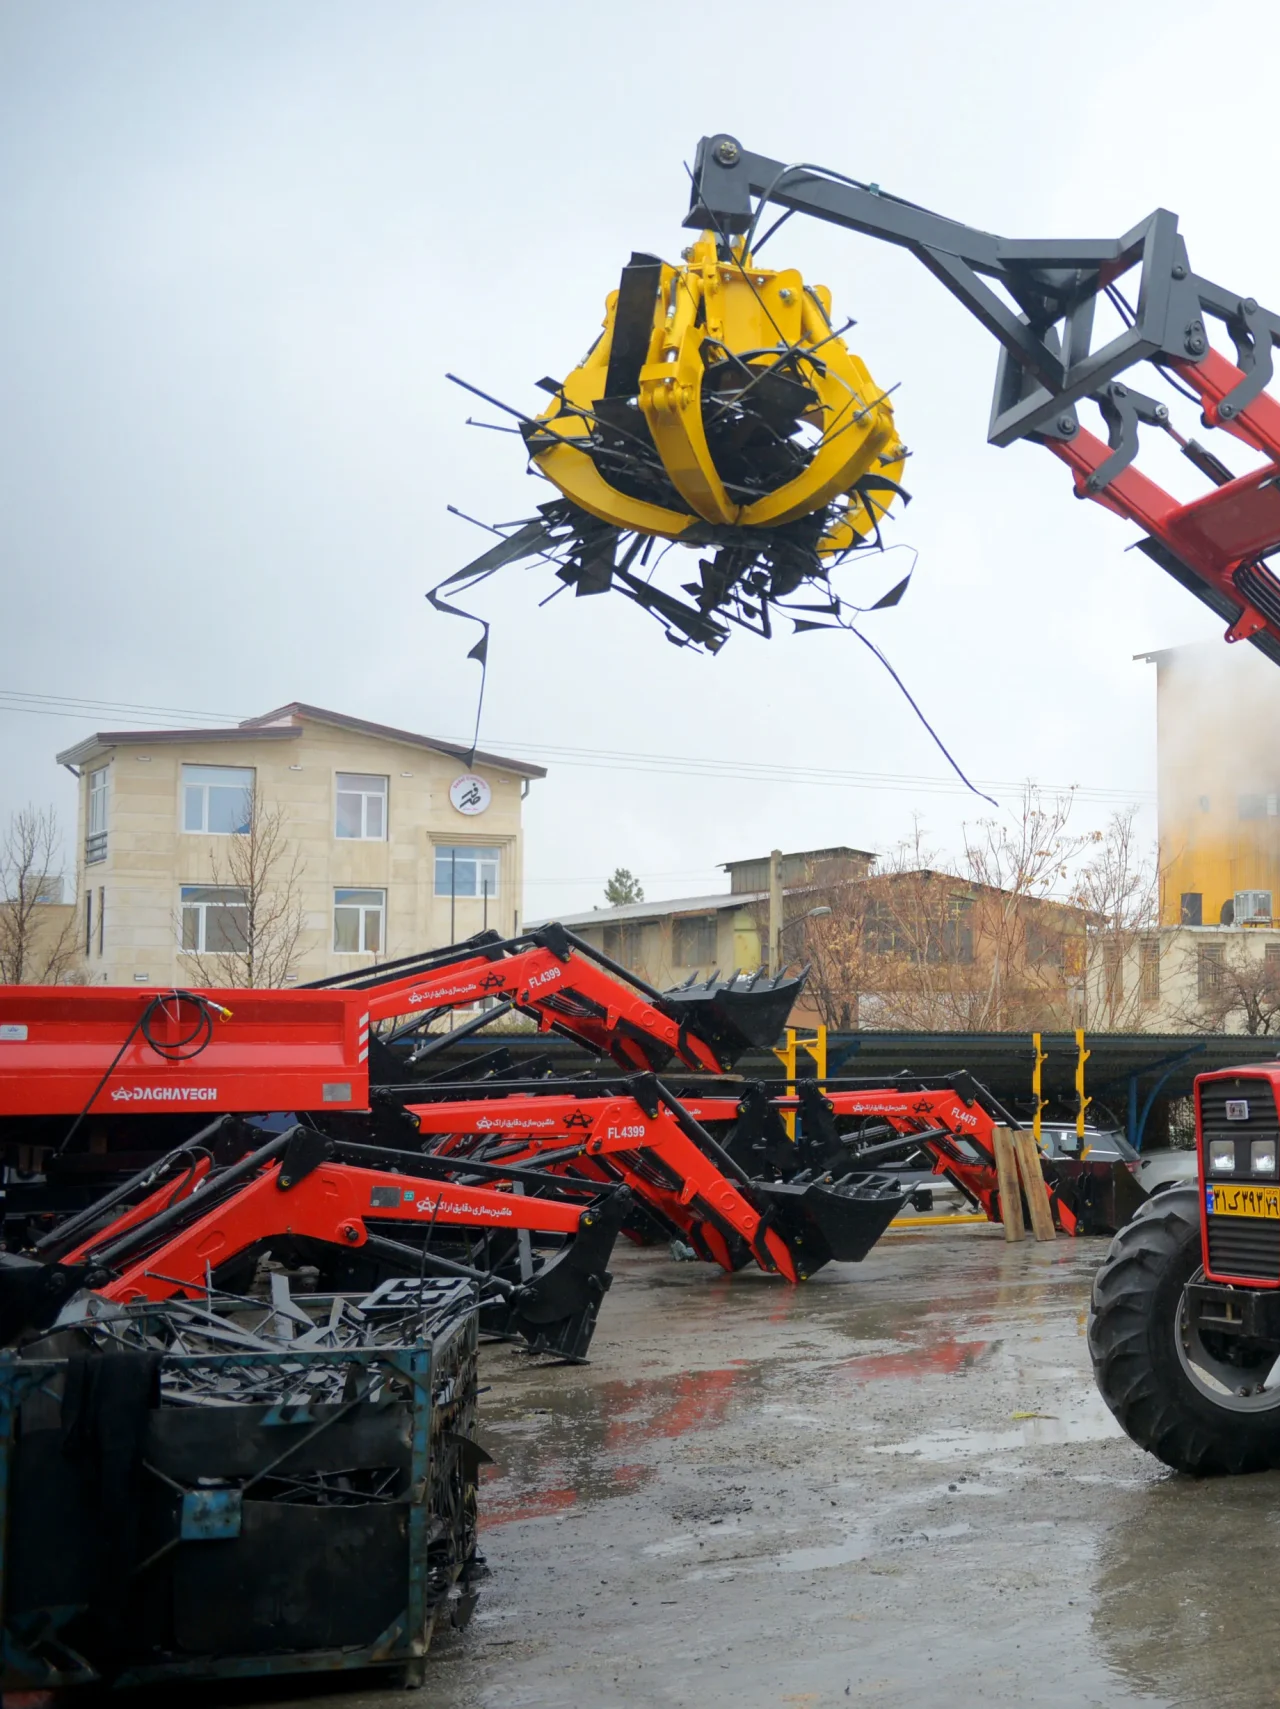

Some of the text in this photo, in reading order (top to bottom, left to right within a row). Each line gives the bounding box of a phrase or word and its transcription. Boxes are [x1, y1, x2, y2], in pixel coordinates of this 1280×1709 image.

[528, 967, 562, 988] FL4399
[133, 1088, 217, 1100] DAGHAYEGH
[951, 1107, 978, 1126] FL4475
[607, 1126, 645, 1139] FL4399
